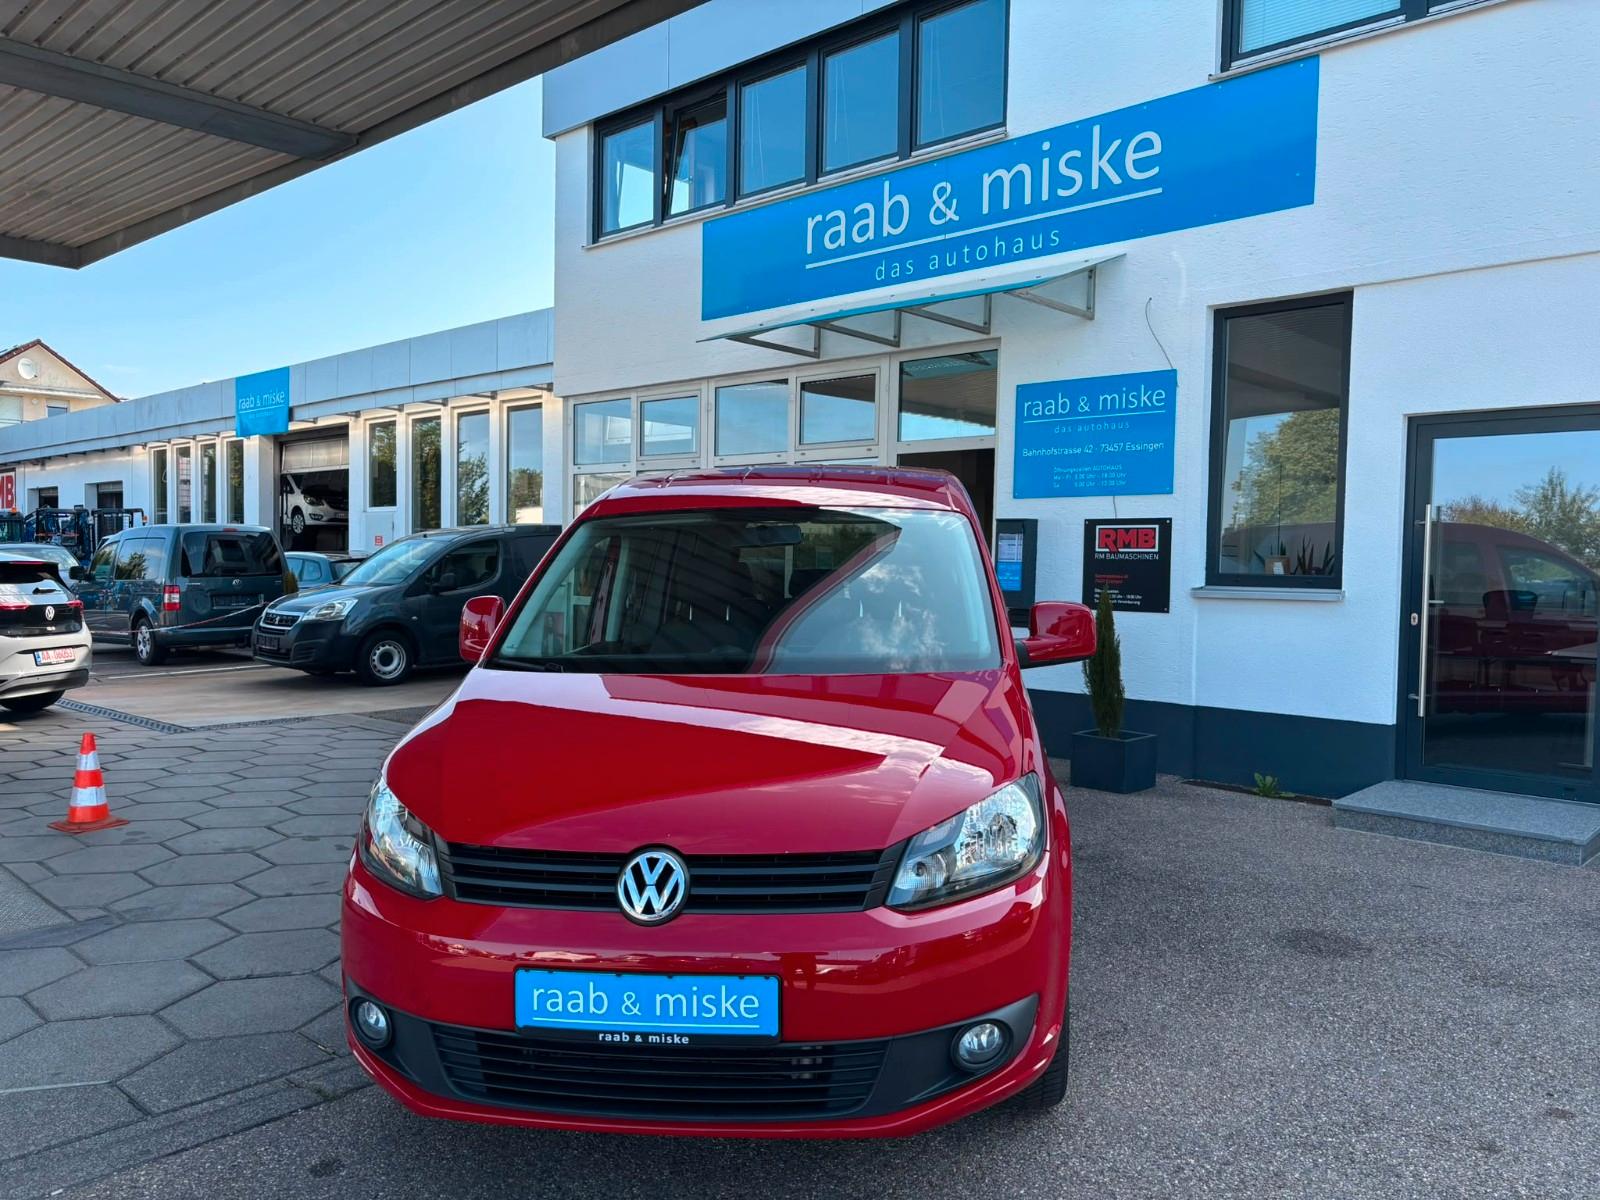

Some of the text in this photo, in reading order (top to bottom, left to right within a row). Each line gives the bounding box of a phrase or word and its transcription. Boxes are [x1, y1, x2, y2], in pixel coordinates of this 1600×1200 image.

[806, 124, 1162, 254] raab & miske
[875, 229, 1060, 281] das autohaus
[239, 394, 254, 409] raab
[263, 388, 285, 406] miske
[1024, 384, 1165, 417] raab & miske
[1054, 421, 1130, 433] das autohaus
[1022, 446, 1082, 457] Bahnhofstrasse
[1084, 444, 1094, 454] 42
[1101, 442, 1124, 453] 73457
[1126, 441, 1164, 452] Essingen
[1100, 529, 1155, 553] RMB
[533, 981, 760, 1019] raab & miske
[599, 1032, 690, 1044] raab & miske
